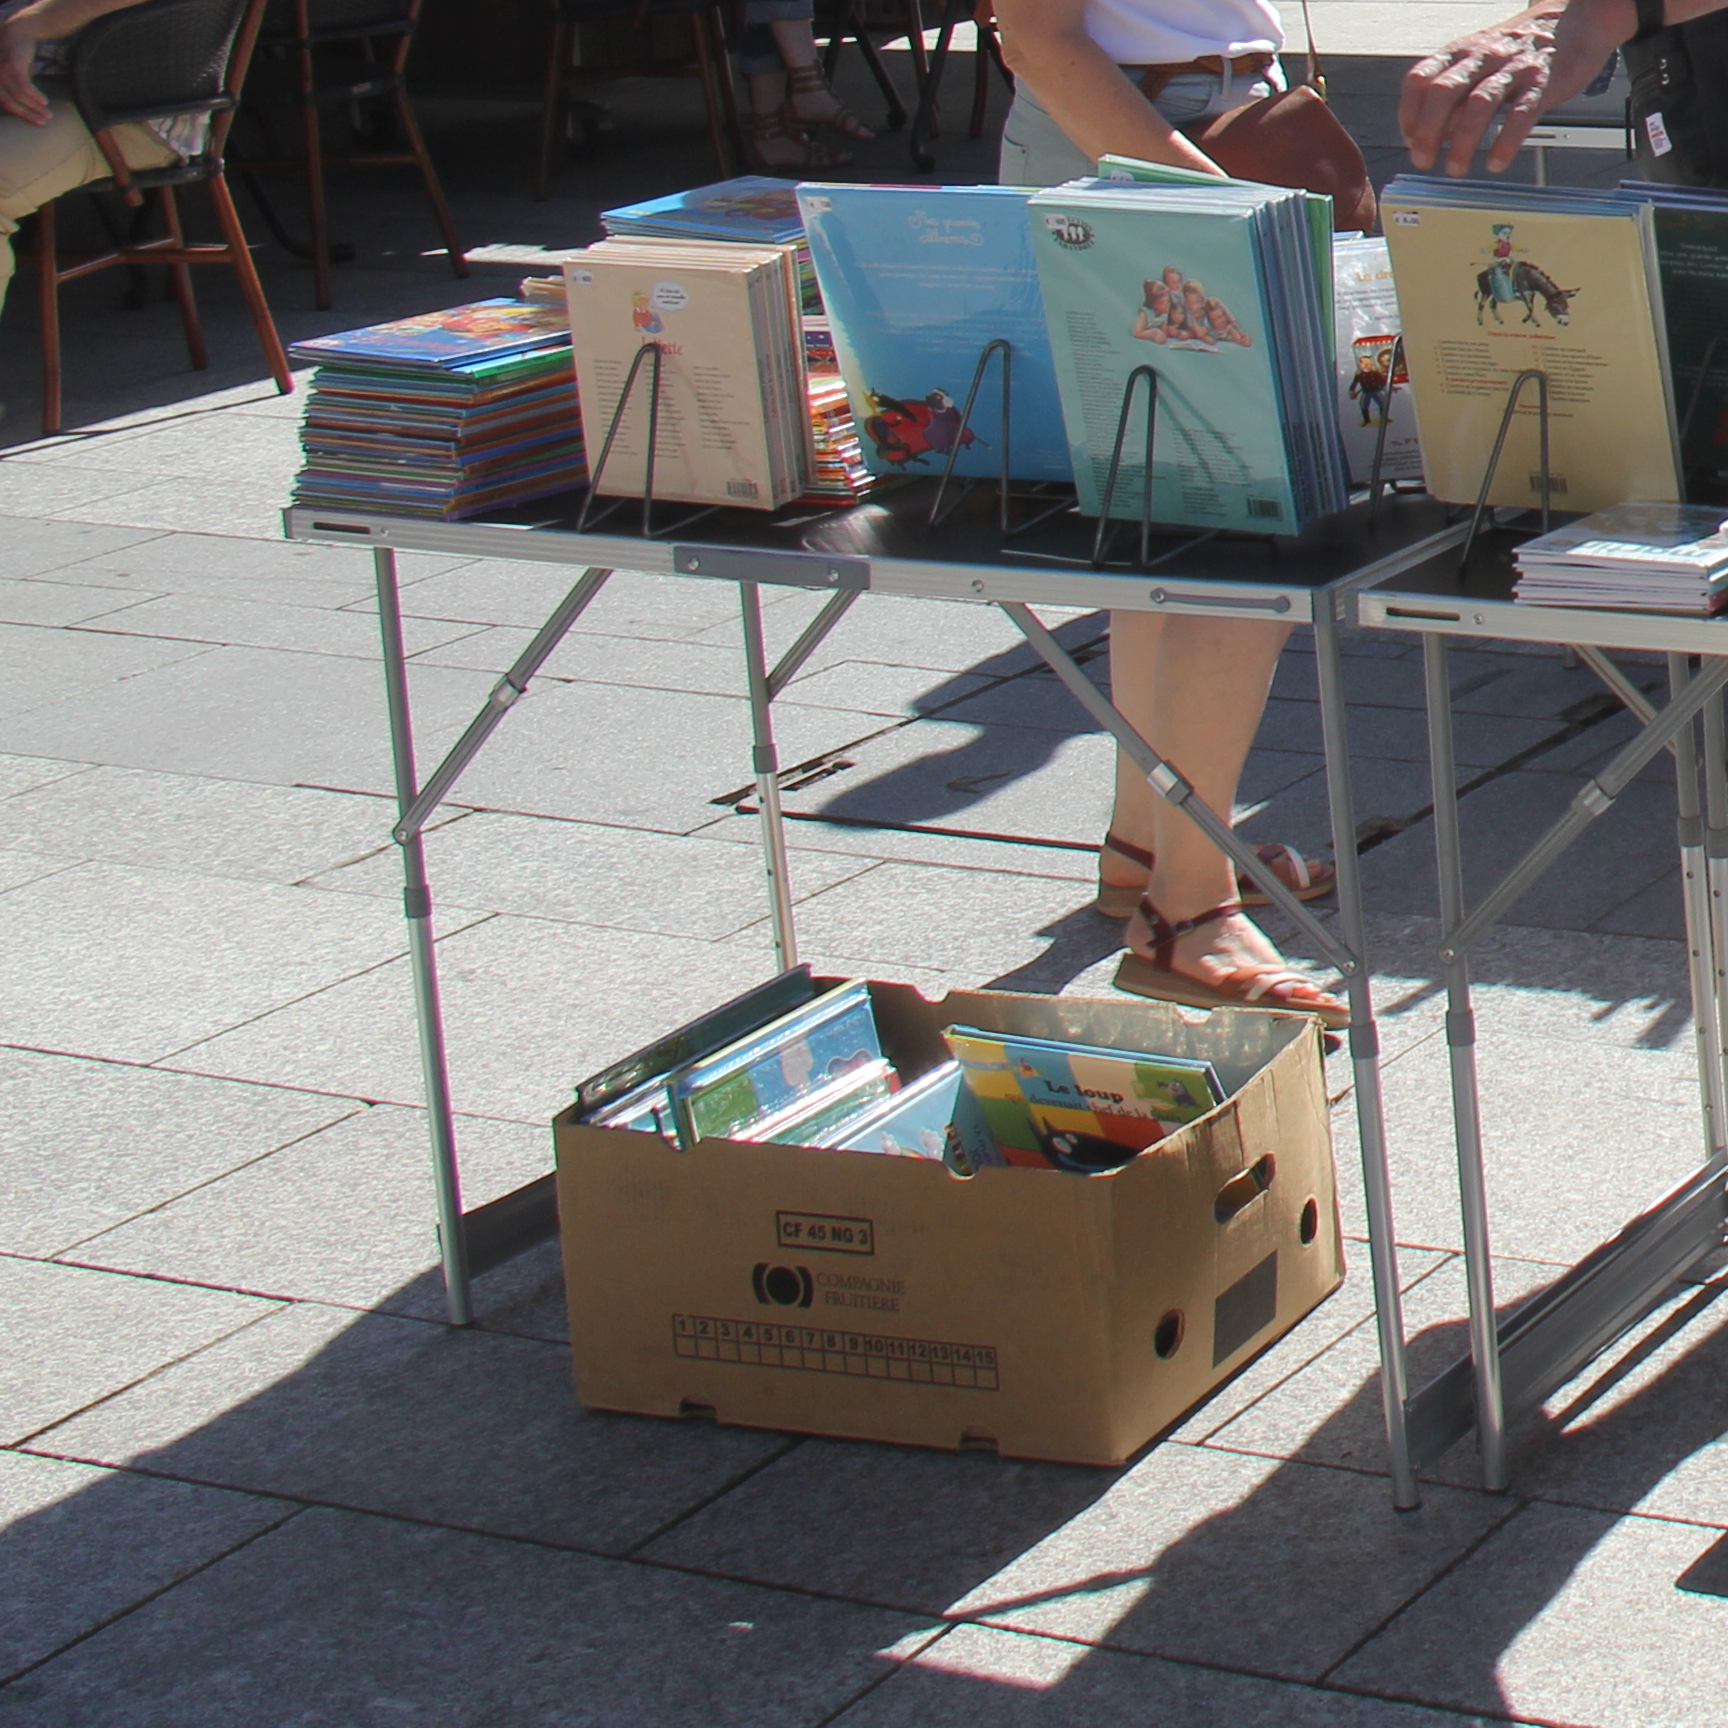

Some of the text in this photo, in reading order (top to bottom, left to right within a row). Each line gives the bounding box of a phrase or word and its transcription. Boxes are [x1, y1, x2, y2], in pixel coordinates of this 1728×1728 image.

[1043, 1079, 1124, 1104] Le loup
[783, 1222, 868, 1245] CF 45 NG 3
[816, 1273, 906, 1296] COMPAGNIE
[699, 1322, 709, 1335] 2
[720, 1323, 730, 1337] 3
[743, 1325, 753, 1339] 4
[764, 1328, 773, 1341] 5
[785, 1330, 795, 1344] 6
[806, 1332, 816, 1346] 7
[826, 1334, 836, 1348] 8
[849, 1336, 859, 1350] 9
[866, 1338, 884, 1353] 10
[889, 1340, 904, 1355] 11
[909, 1342, 927, 1357] 12
[932, 1344, 949, 1360] 13
[954, 1347, 972, 1363] 14
[976, 1348, 993, 1364] 15
